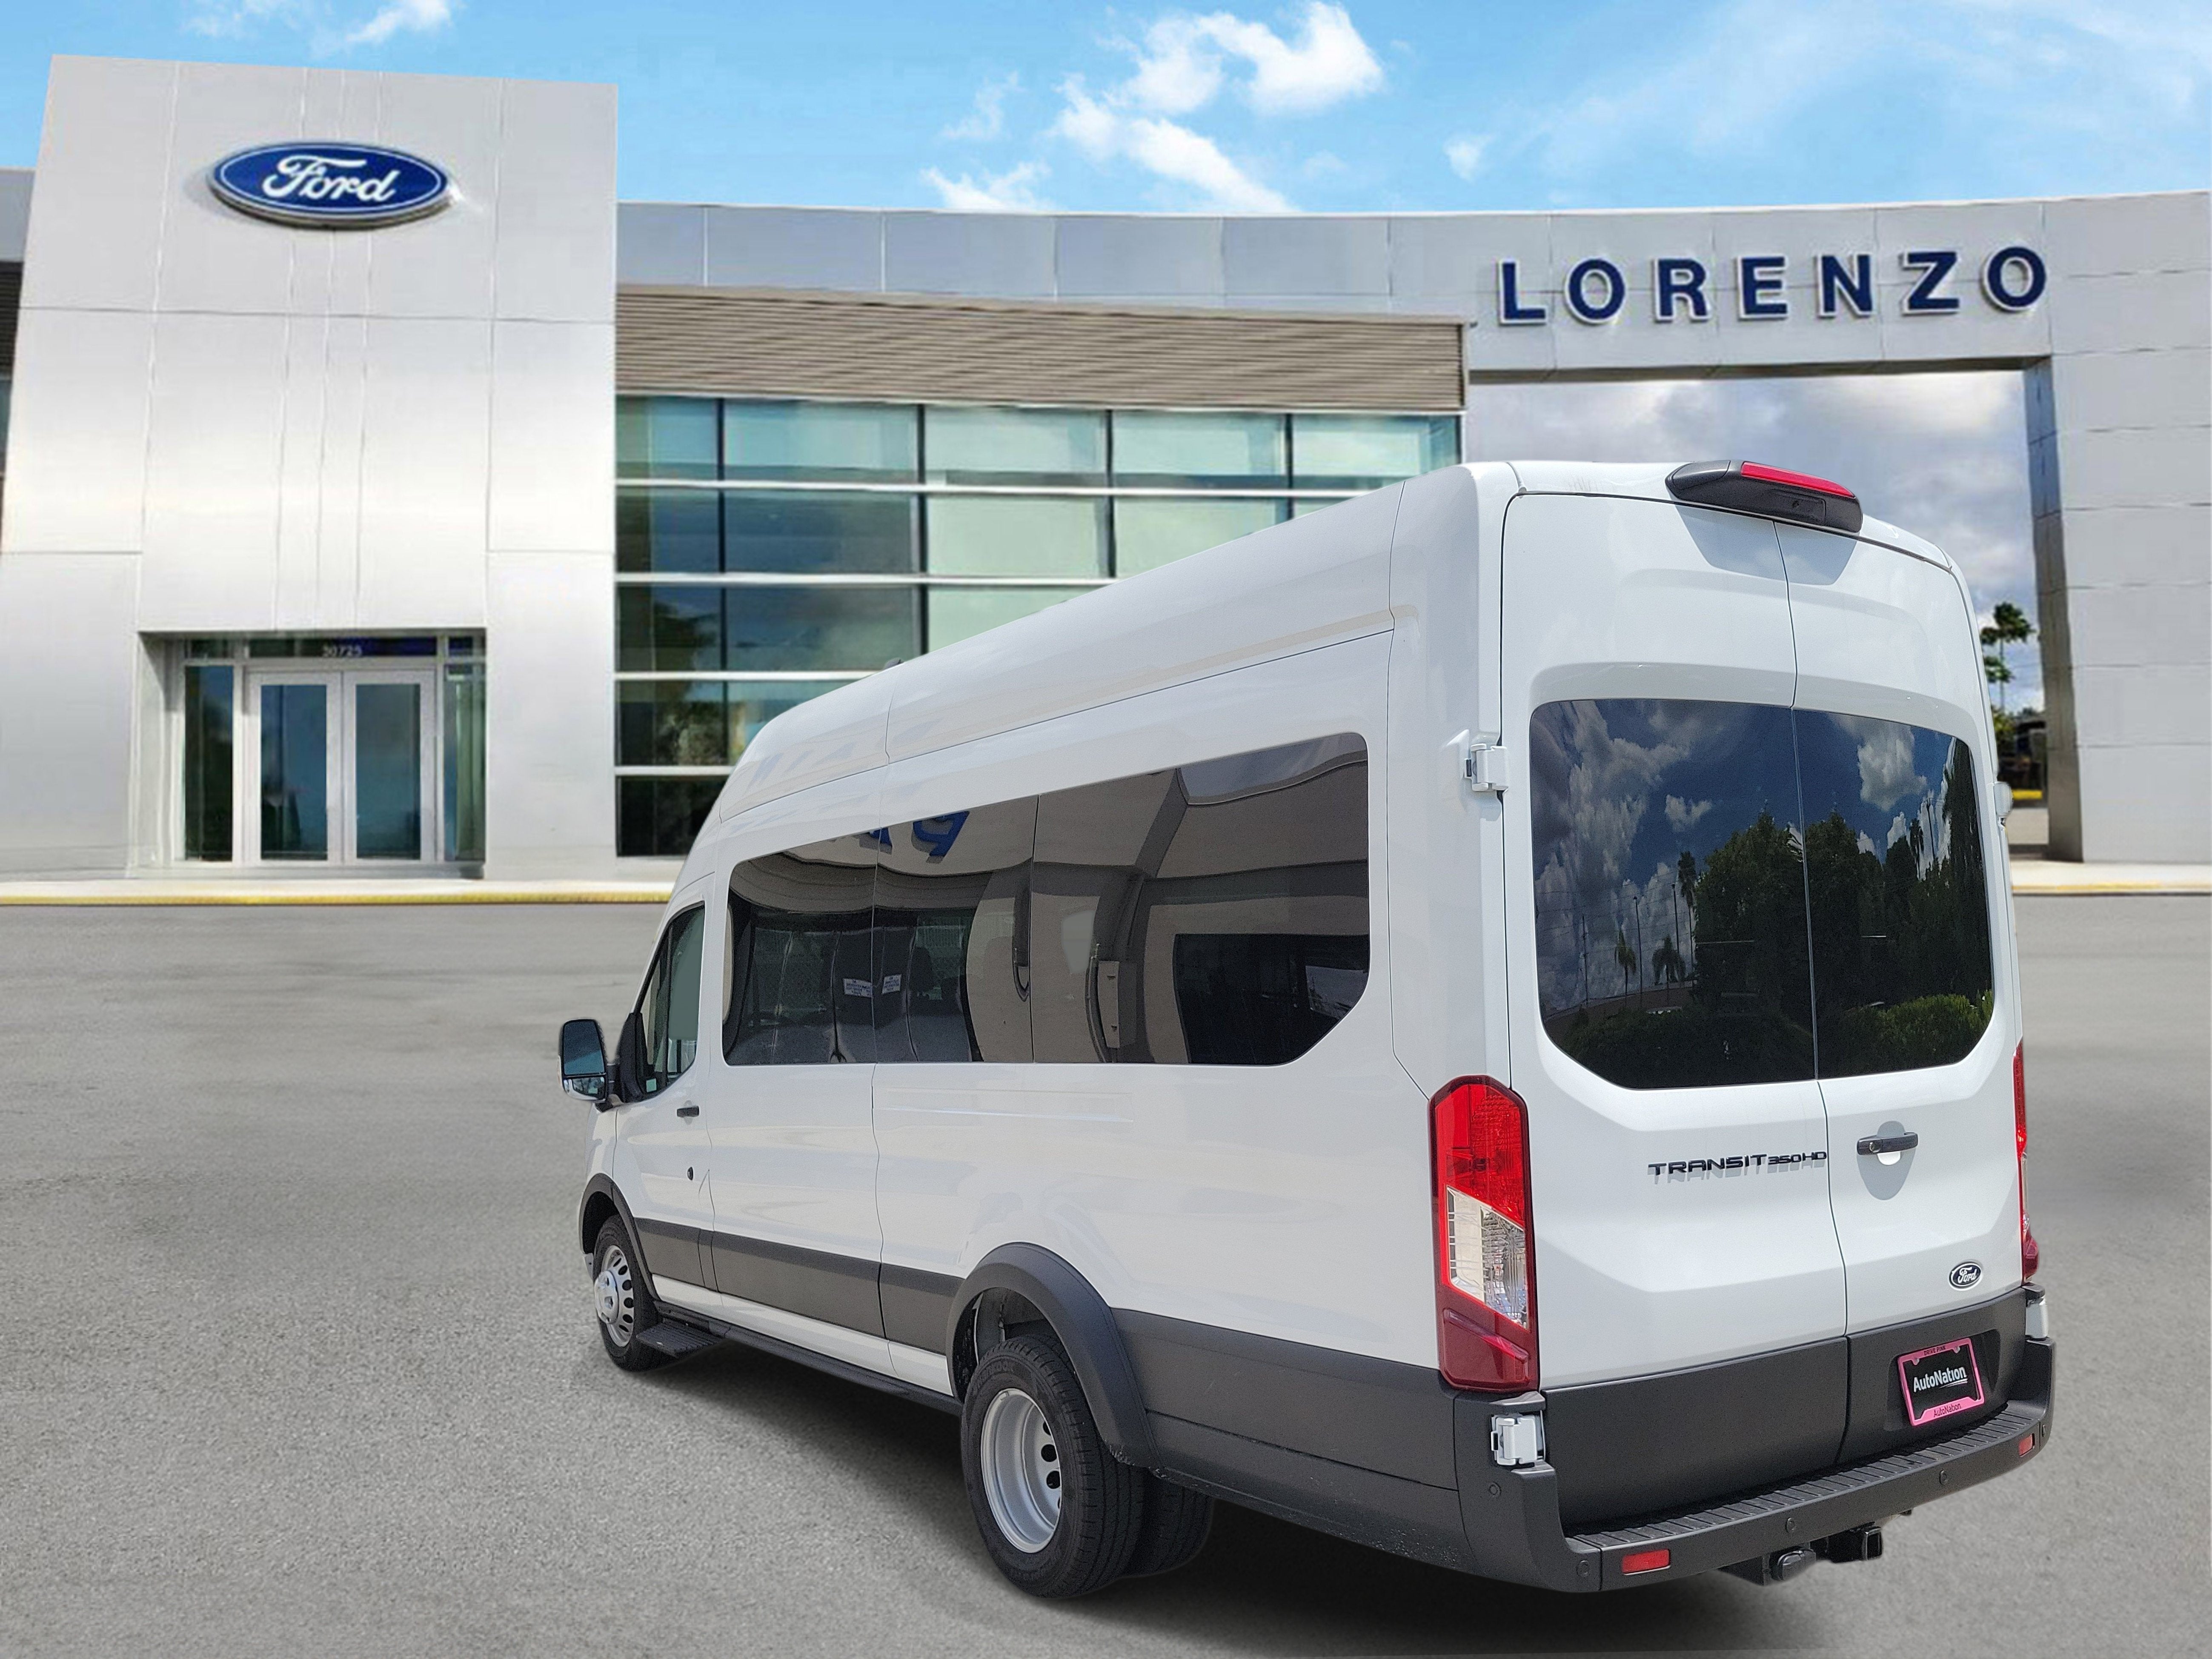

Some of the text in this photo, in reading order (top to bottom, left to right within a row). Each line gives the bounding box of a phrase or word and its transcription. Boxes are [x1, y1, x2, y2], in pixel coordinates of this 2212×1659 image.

[262, 154, 400, 202] Ford
[1499, 247, 2046, 325] LORENZO
[1648, 1151, 1827, 1176] TRANSIT 350HD
[1958, 1267, 1977, 1284] Ford
[1923, 1348, 1936, 1356] DRIVE
[1913, 1366, 1967, 1393] AutoNation
[1933, 1403, 1962, 1418] AutoNation
